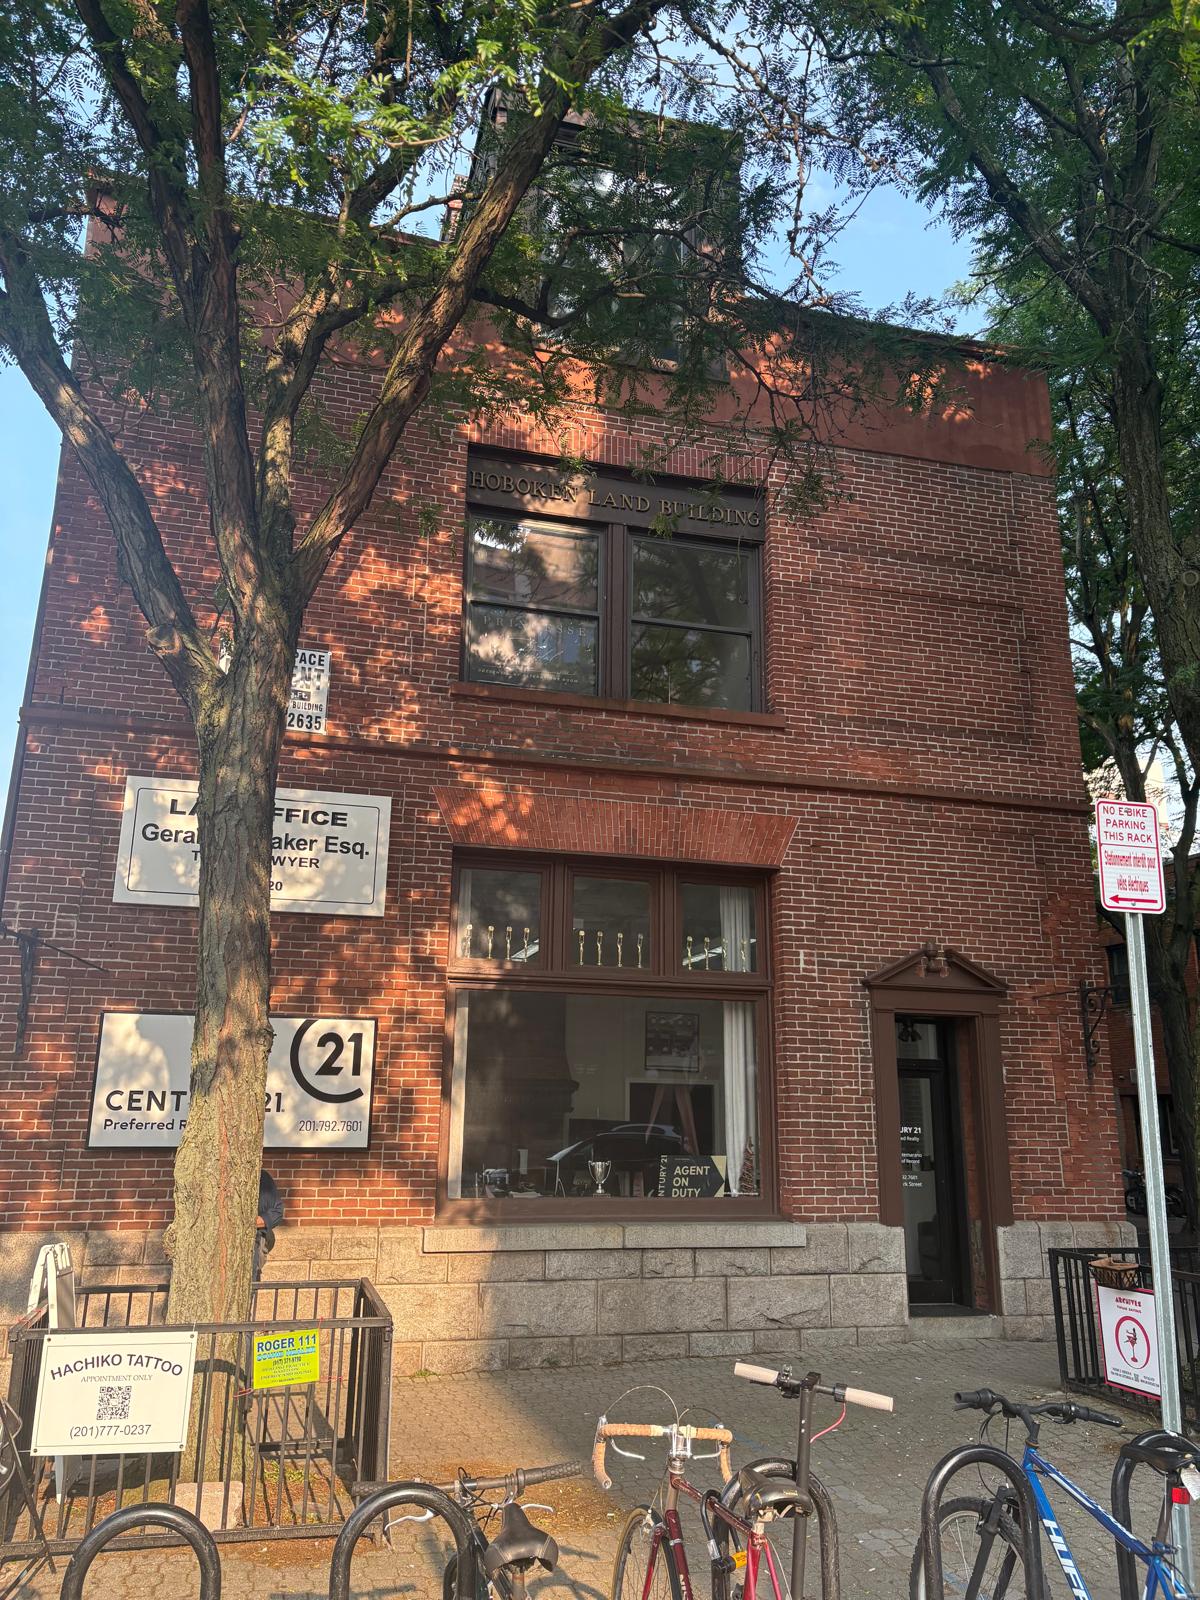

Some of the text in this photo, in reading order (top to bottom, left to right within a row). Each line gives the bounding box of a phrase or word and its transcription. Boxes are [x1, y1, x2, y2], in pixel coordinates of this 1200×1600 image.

[470, 471, 760, 527] HOBOKEN LAND BUILDING
[484, 615, 586, 637] PRINESSE
[293, 702, 323, 712] BUILDING
[272, 807, 348, 827] FFICE
[1103, 806, 1115, 816] NO
[1106, 818, 1146, 830] PARKING
[1104, 831, 1152, 843] THIS RACK
[325, 836, 370, 859] Esq.
[104, 1118, 174, 1131] Preferred
[299, 1120, 362, 1132] 201.792.7601
[674, 1166, 710, 1176] AGENT
[673, 1177, 688, 1187] ON
[672, 1188, 701, 1198] DUTY
[257, 1334, 316, 1352] ROGER 111
[50, 1353, 183, 1380] HACHIKO TATTOO
[80, 1374, 153, 1383] APPOINTMENT ONLY
[69, 1424, 152, 1440] (201)777-0237
